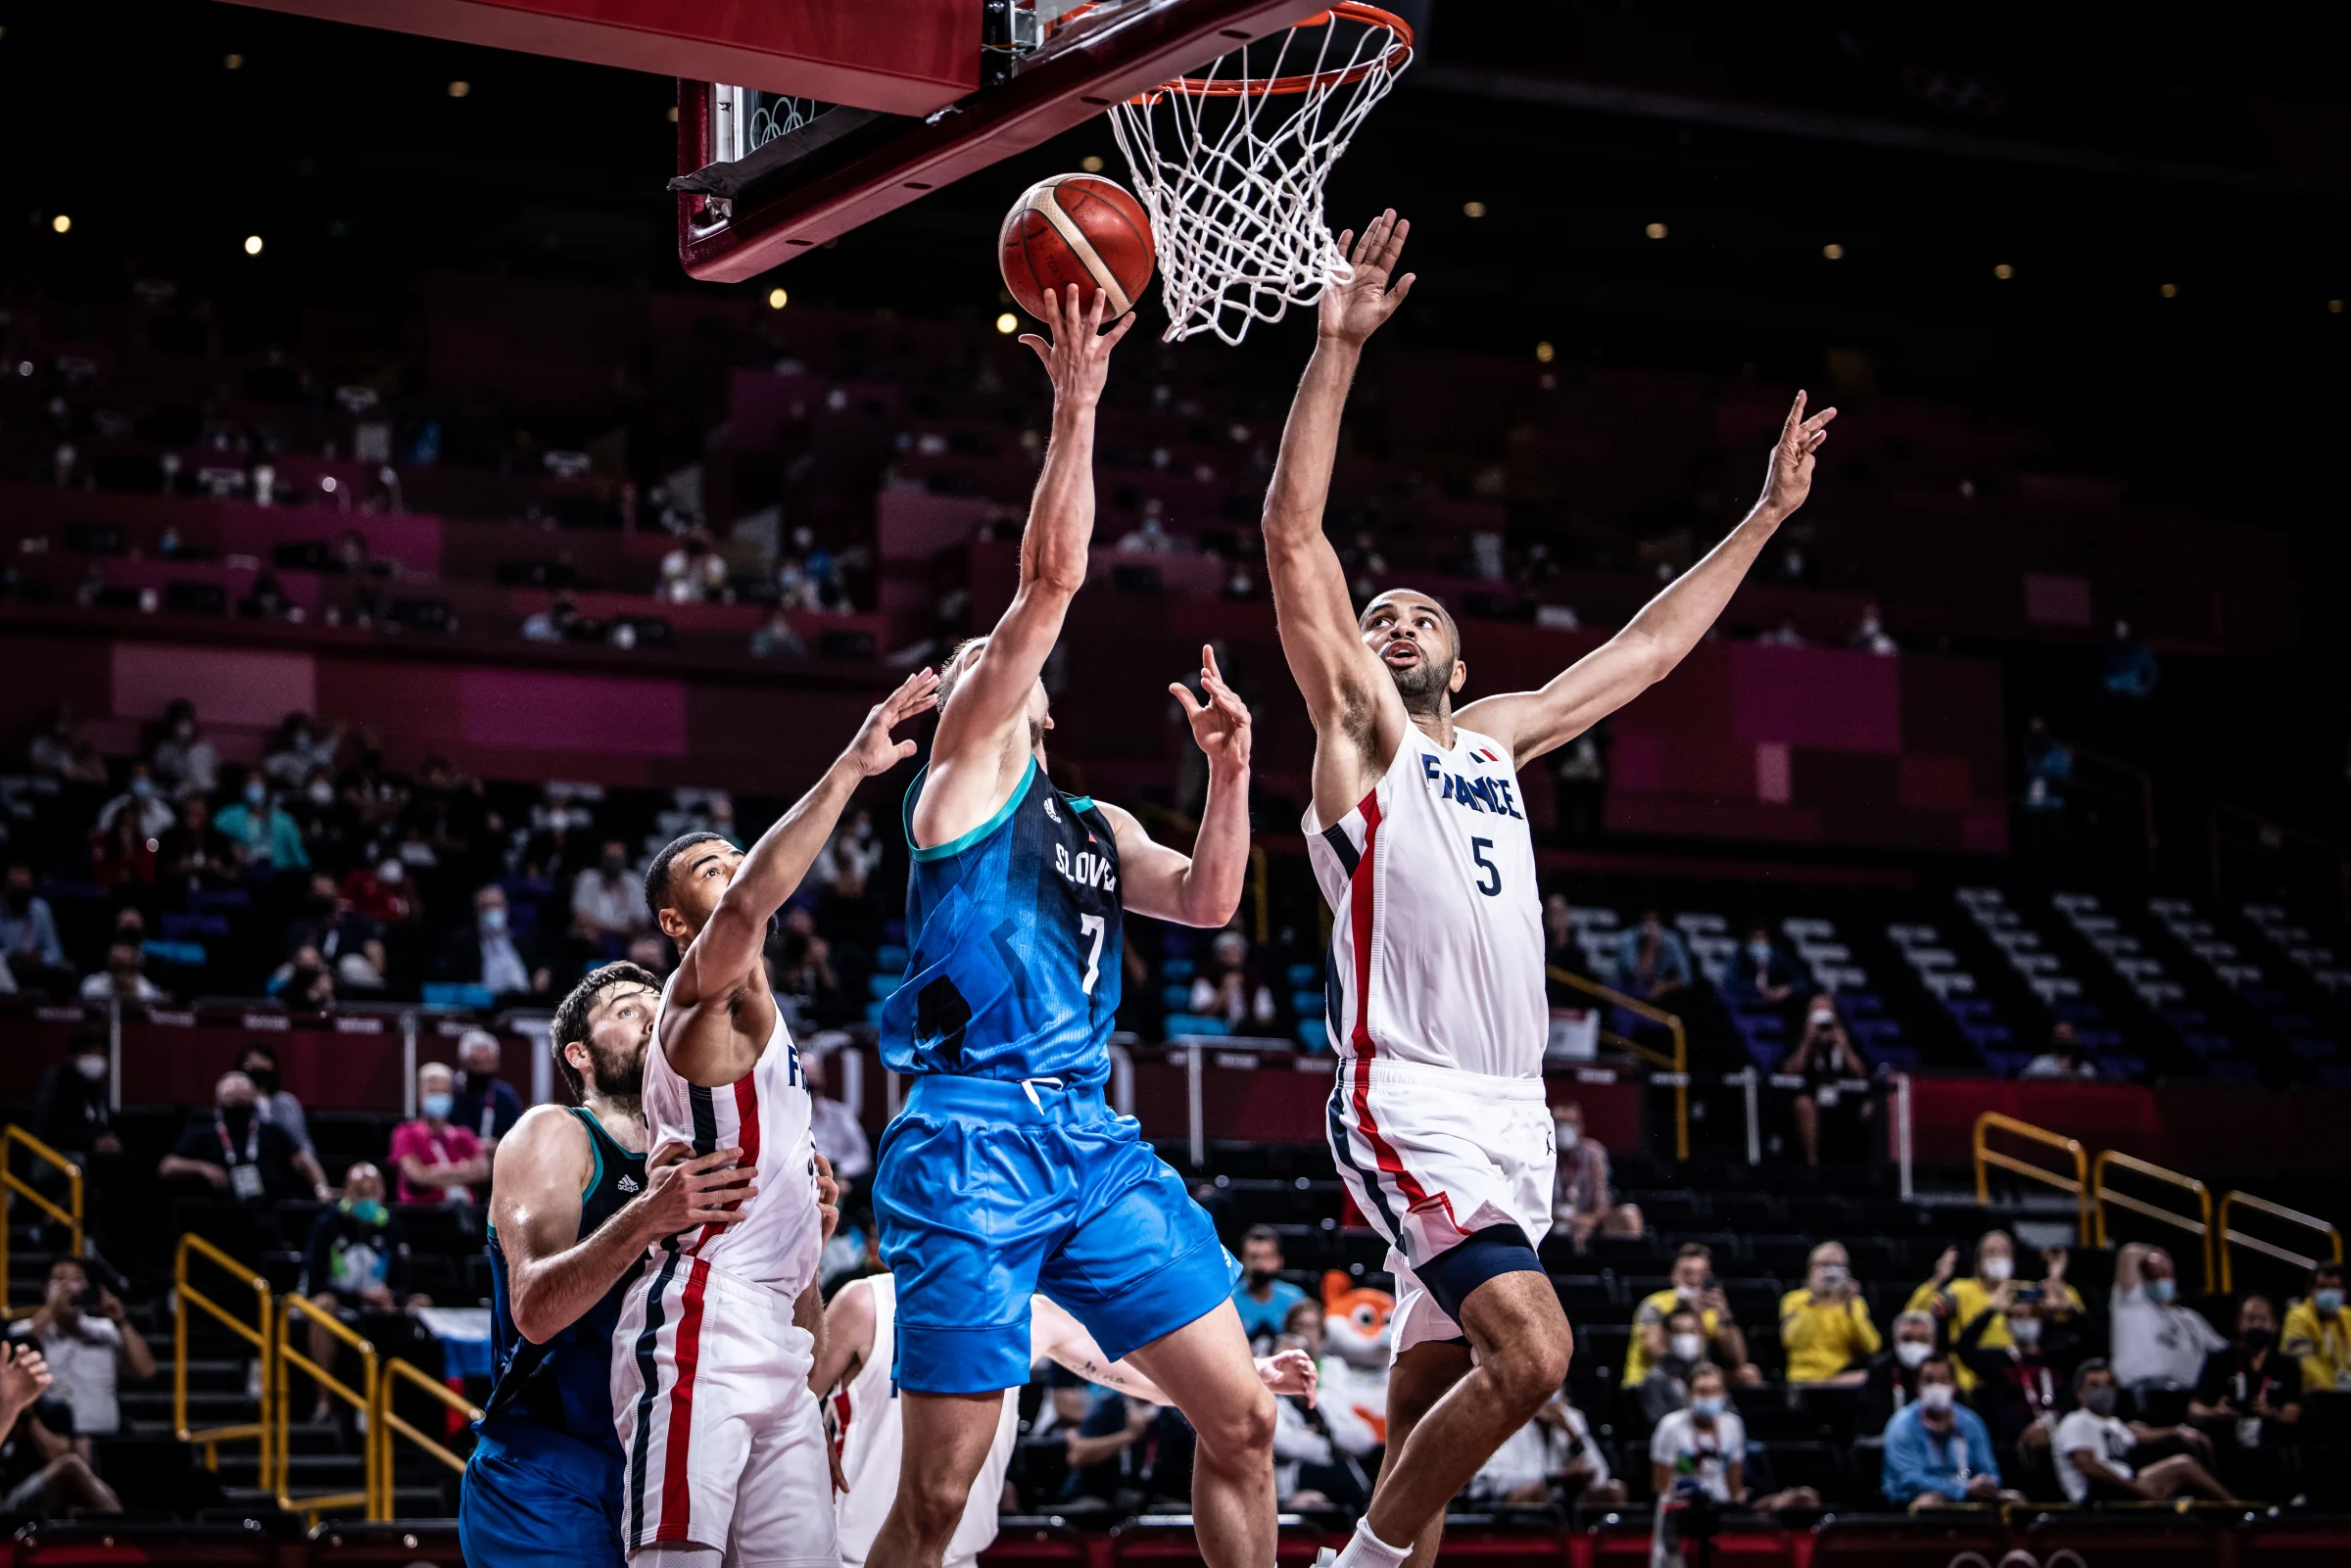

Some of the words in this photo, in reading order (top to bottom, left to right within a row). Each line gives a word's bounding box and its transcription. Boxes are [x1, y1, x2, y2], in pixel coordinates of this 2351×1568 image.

[1044, 253, 1070, 288] TOKYO
[1420, 752, 1524, 821] FRANCE
[1055, 842, 1117, 892] SLOVE
[1471, 835, 1503, 897] 5
[1080, 912, 1105, 996] 7
[617, 1183, 640, 1193] adida
